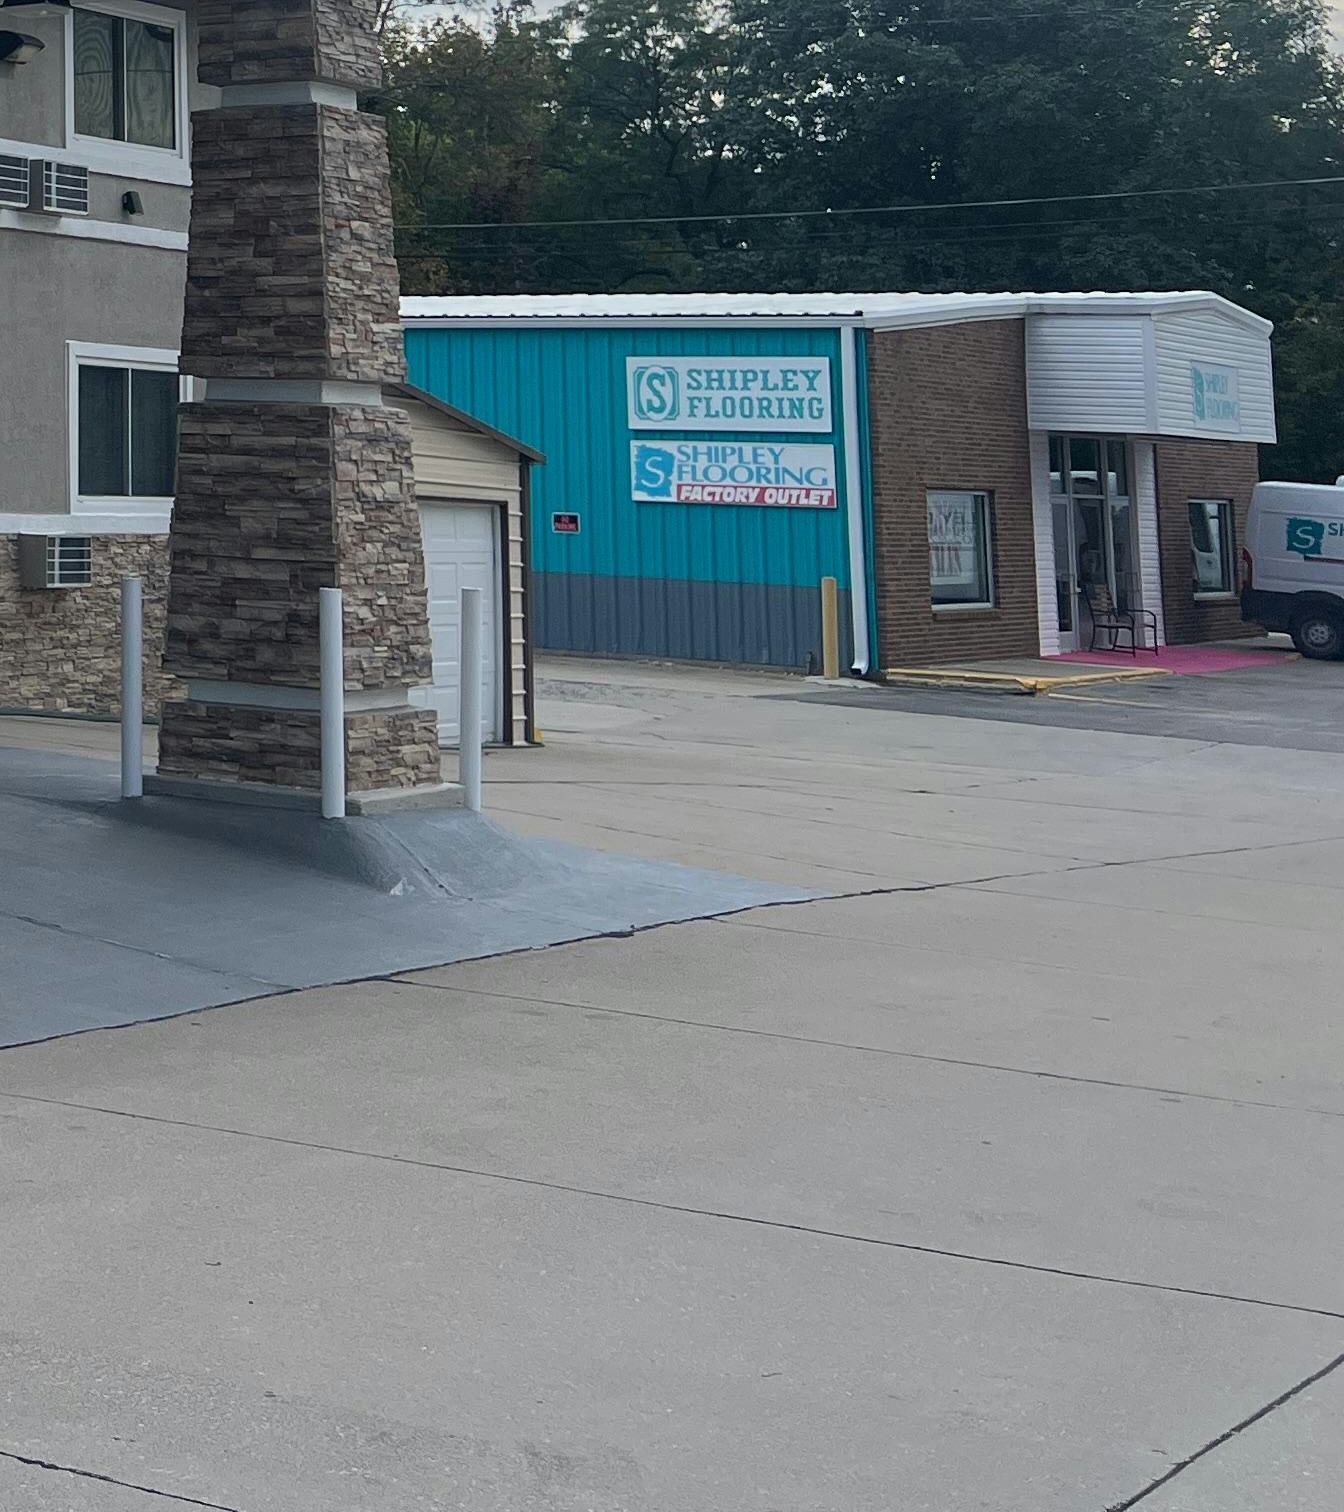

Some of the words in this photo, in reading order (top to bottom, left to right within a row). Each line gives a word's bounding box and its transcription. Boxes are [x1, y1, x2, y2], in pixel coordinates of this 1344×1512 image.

[686, 368, 822, 392] SHIPLEY
[687, 396, 824, 420] FLOORING
[676, 444, 785, 465] SHIPLEY
[677, 463, 828, 486] FLOORING
[679, 485, 760, 503] FACTORY
[764, 487, 833, 506] OUTLET
